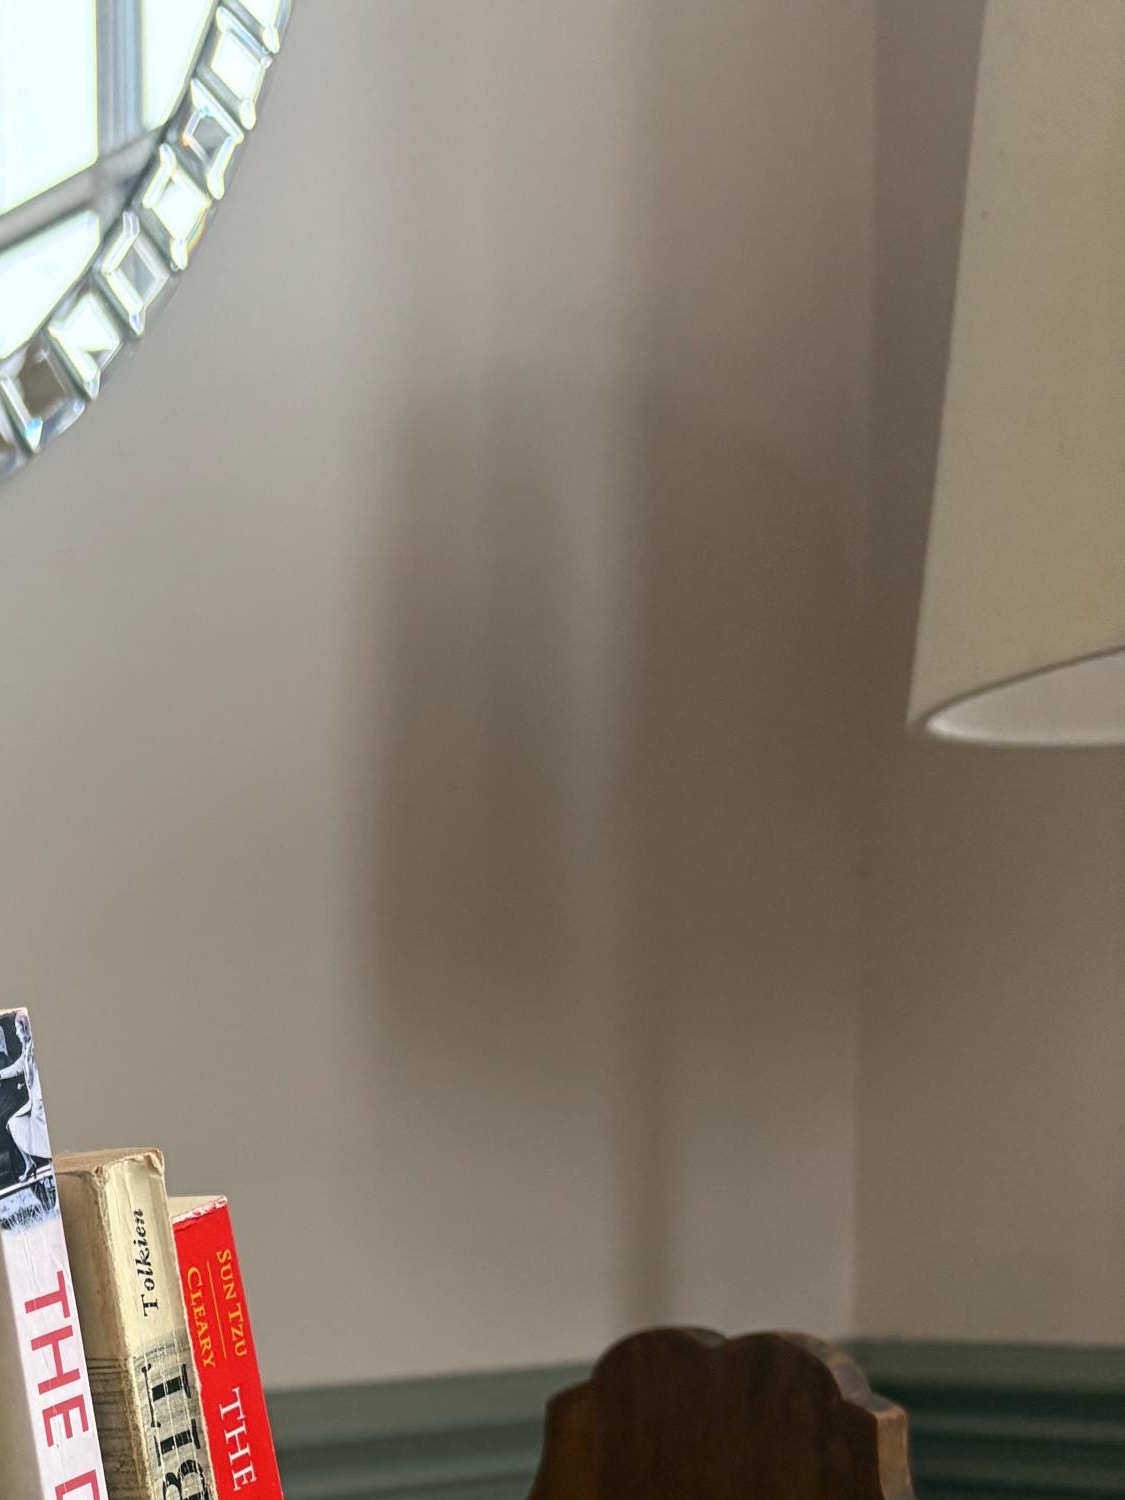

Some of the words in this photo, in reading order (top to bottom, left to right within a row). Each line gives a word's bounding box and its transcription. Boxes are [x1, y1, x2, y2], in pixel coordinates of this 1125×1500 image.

[133, 1208, 159, 1317] Tolkien
[187, 1266, 216, 1368] CLEARY
[216, 1249, 237, 1301] SUN
[228, 1303, 248, 1358] TZU
[24, 1270, 89, 1448] THE
[219, 1387, 257, 1492] THE
